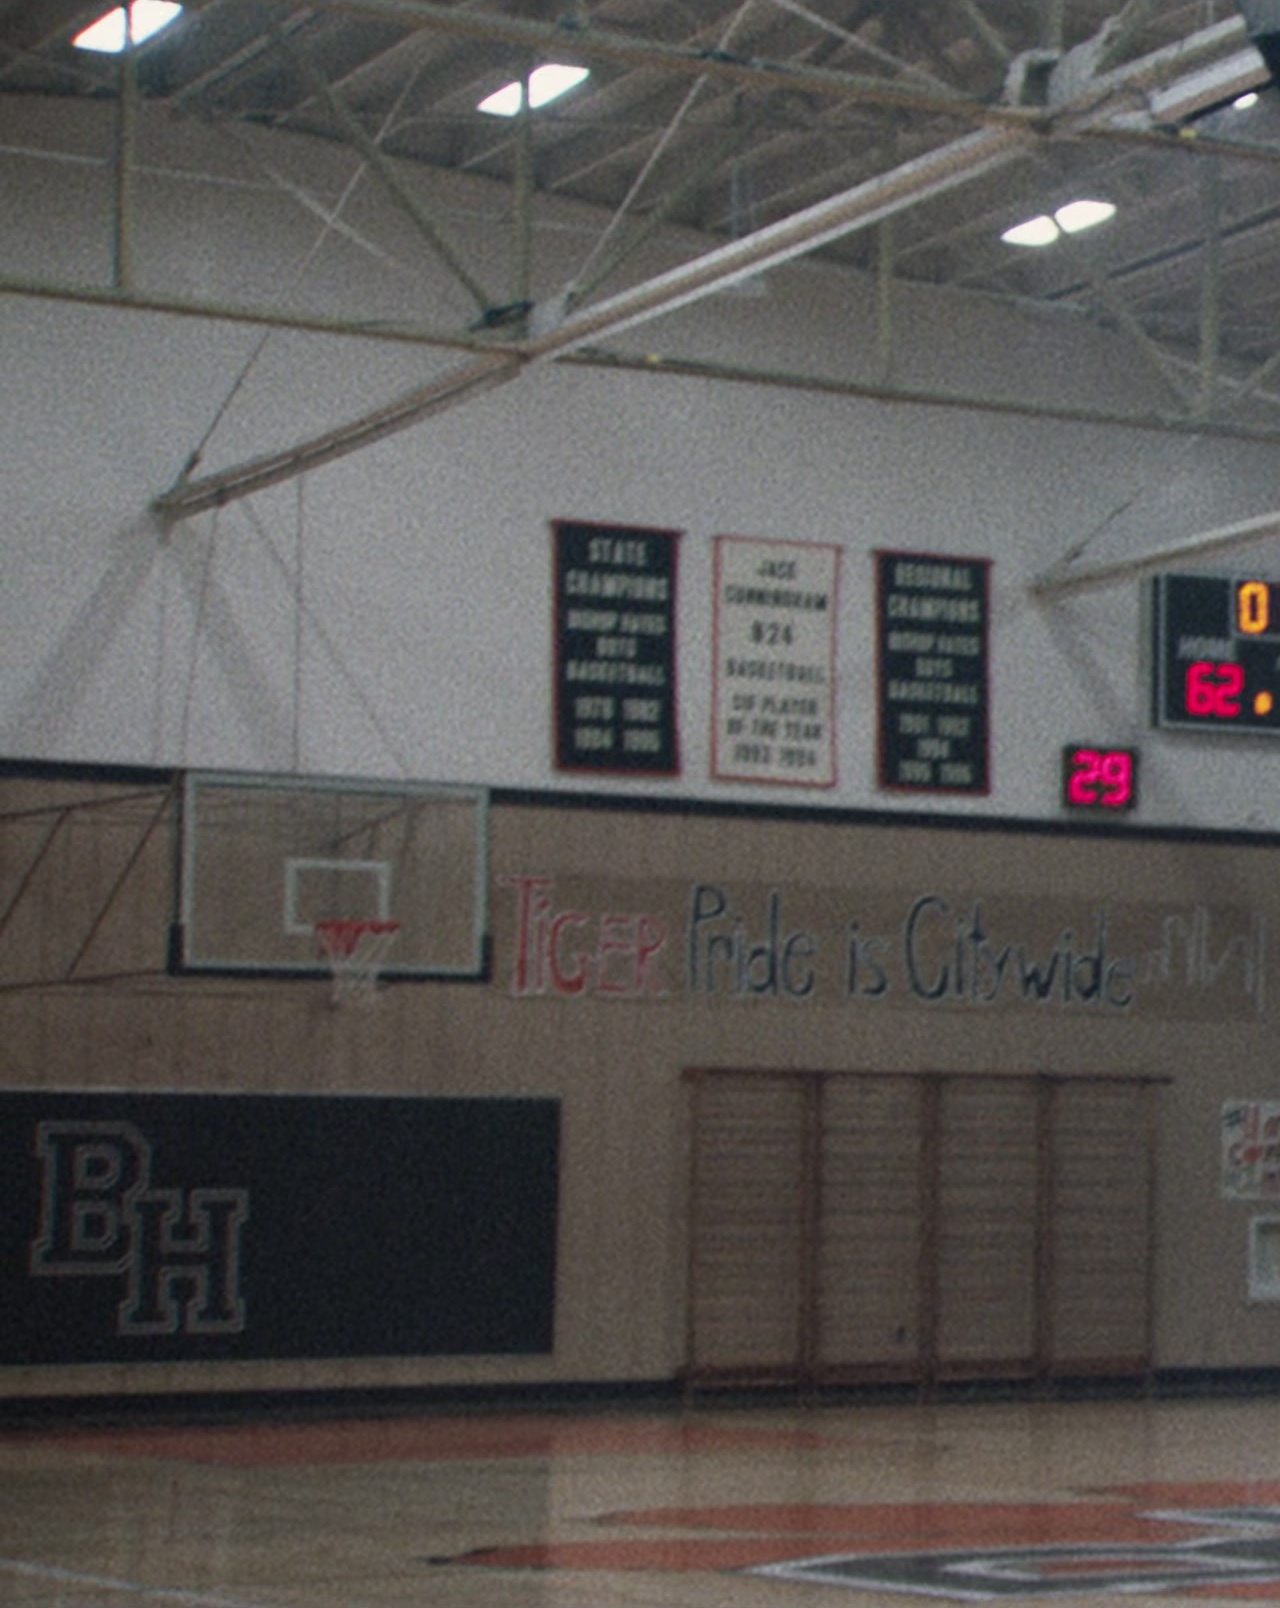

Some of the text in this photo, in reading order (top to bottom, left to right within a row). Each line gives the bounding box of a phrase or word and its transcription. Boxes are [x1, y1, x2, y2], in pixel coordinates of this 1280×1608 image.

[588, 537, 647, 566] STATE
[565, 568, 669, 601] CHAMPIONS
[894, 562, 973, 592] REGIONAL
[888, 594, 981, 622] CHAMPIONS
[565, 660, 667, 686] BASKETBALL
[726, 659, 825, 684] BASKETBALL
[888, 681, 979, 705] BASKETBALL
[1186, 661, 1245, 717] 62
[752, 718, 777, 739] THE
[1067, 748, 1134, 807] 29
[687, 885, 815, 997] Pride
[849, 920, 888, 997] is
